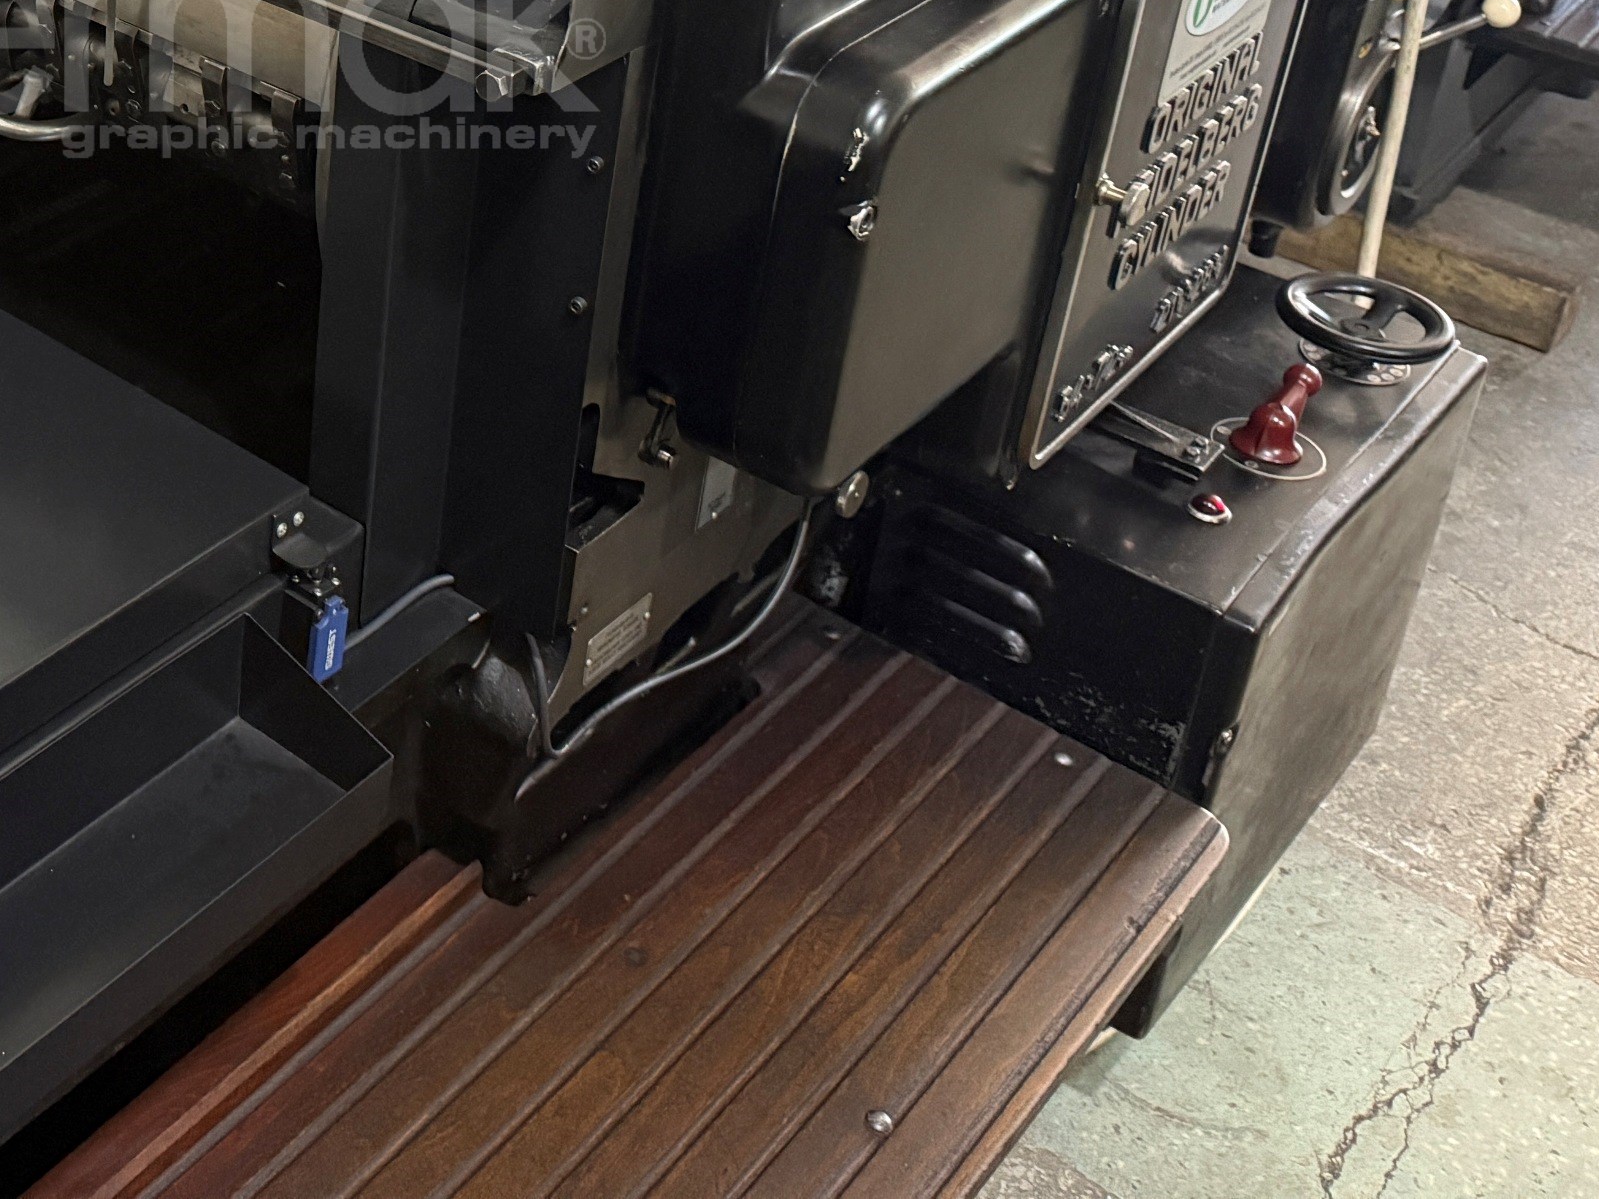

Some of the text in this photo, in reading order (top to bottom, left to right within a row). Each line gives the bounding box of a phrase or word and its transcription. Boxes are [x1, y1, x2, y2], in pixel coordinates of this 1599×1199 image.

[1145, 30, 1264, 154] ORIGINAL
[1107, 83, 1263, 239] IDELBERG
[1110, 160, 1231, 291] CYLINDER
